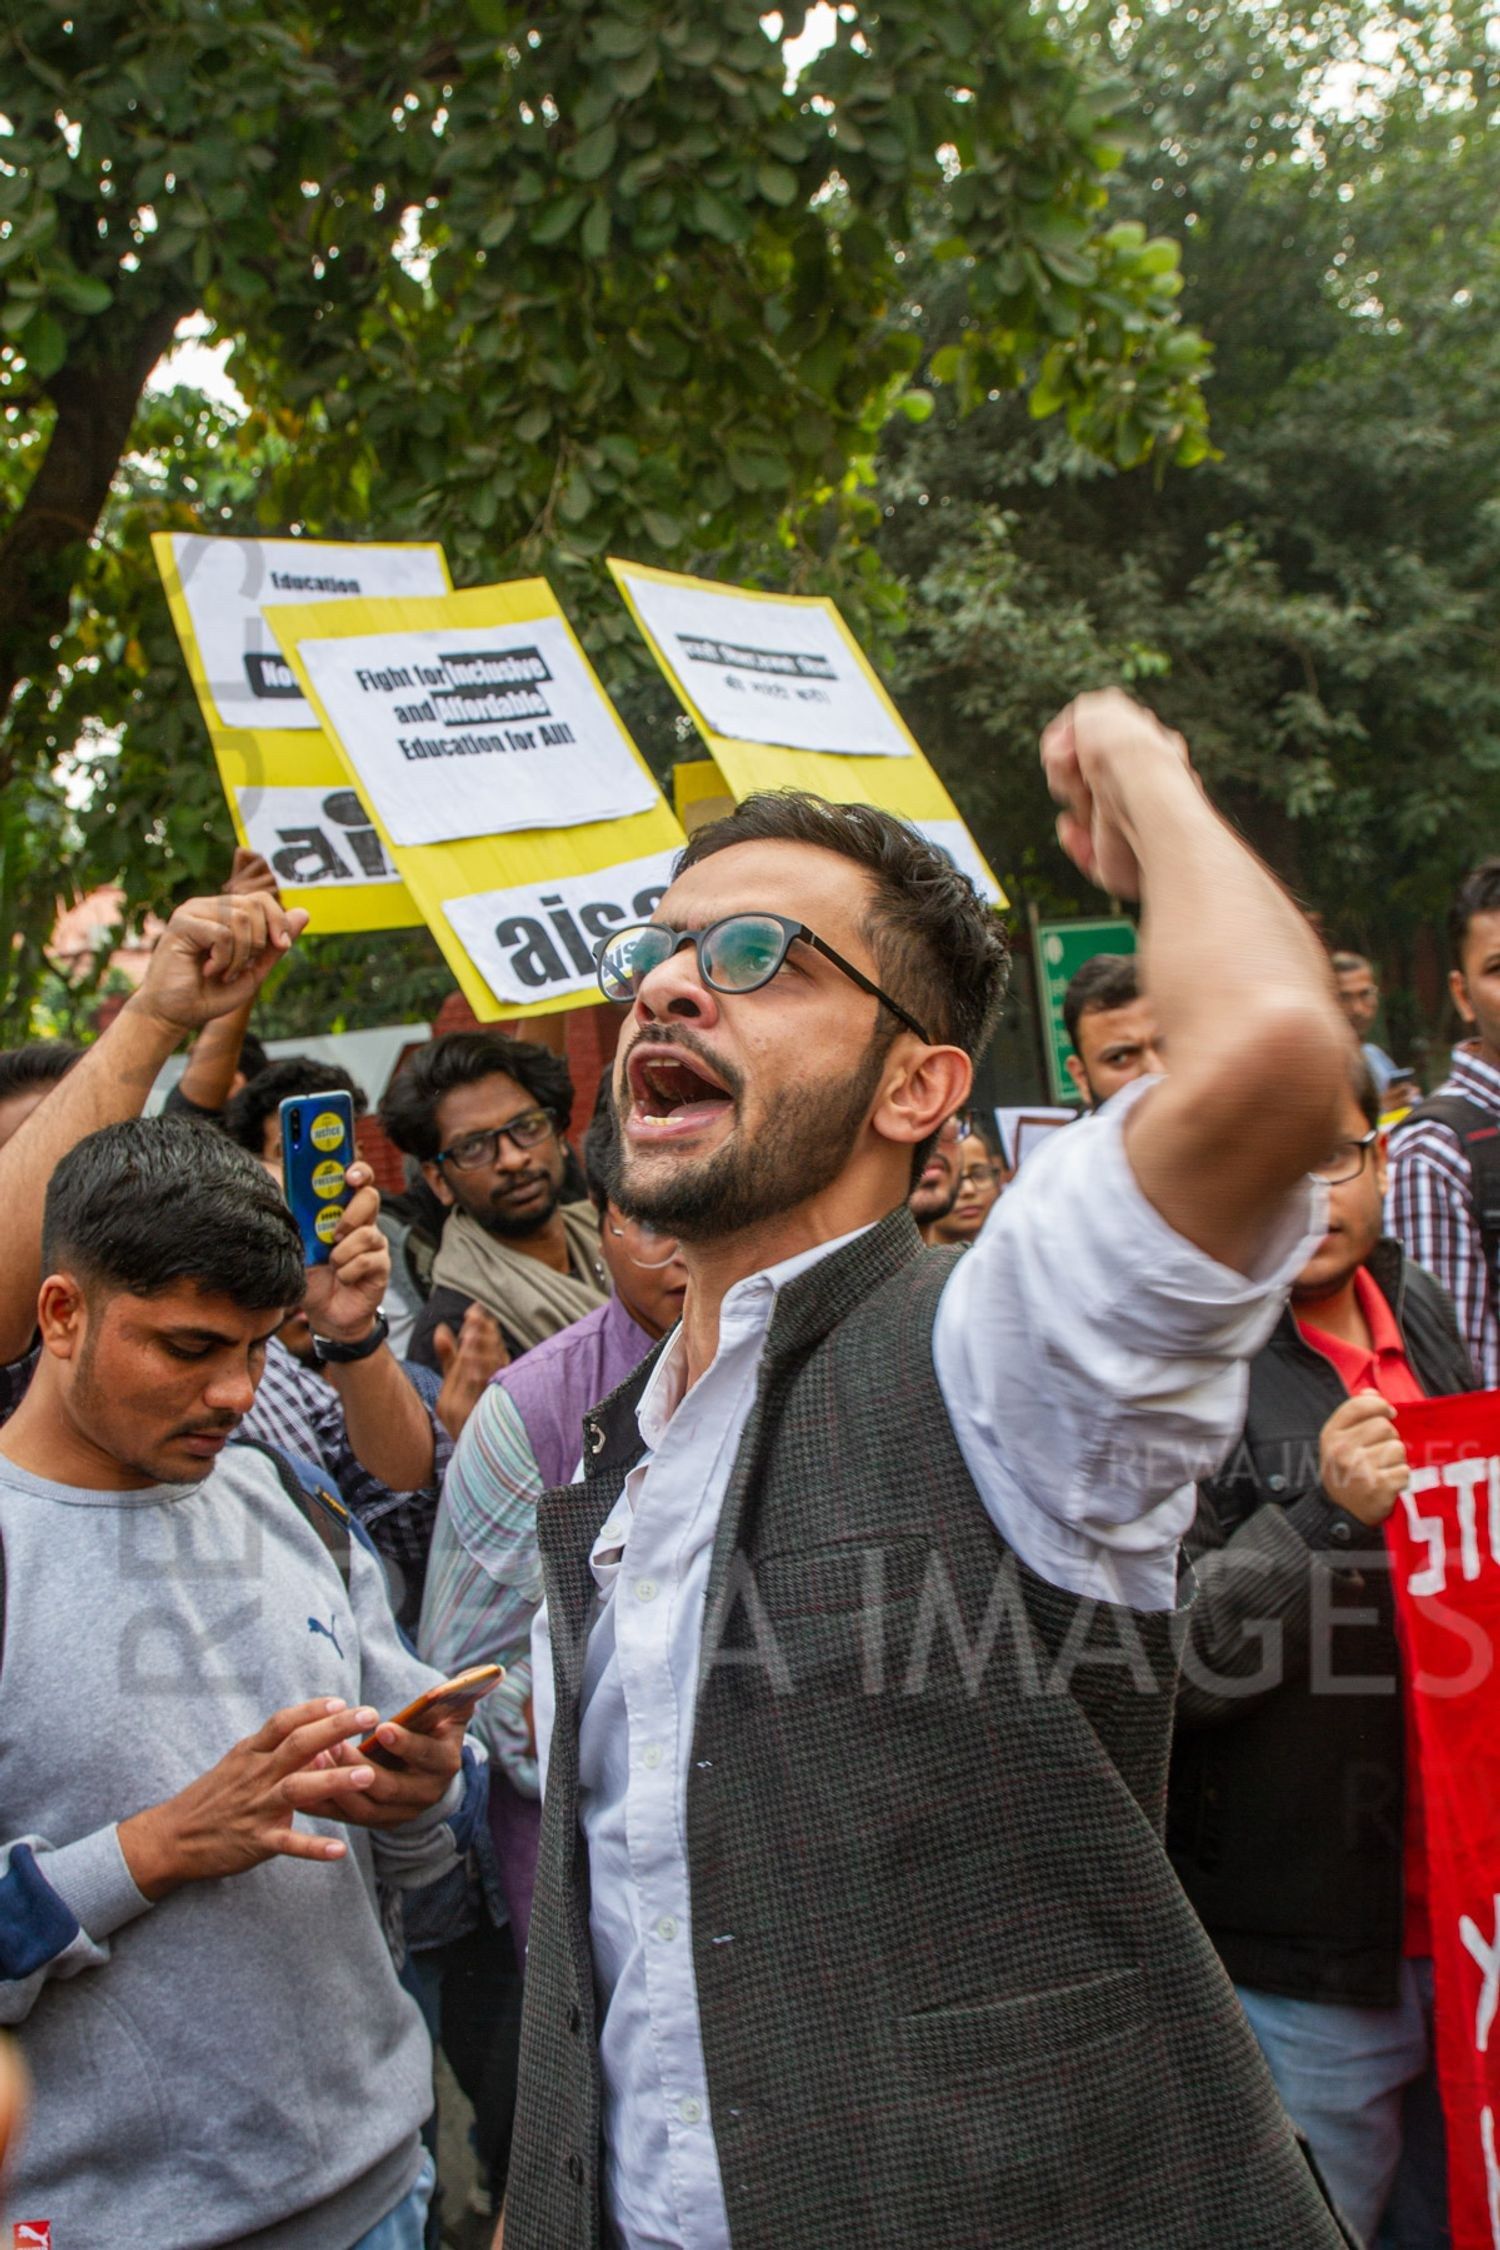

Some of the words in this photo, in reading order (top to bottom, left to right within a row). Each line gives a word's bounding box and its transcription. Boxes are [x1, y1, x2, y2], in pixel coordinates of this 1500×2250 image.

[270, 571, 361, 594] Education
[355, 664, 416, 692] Fight
[412, 663, 447, 686] for
[444, 655, 549, 688] Inclusive
[393, 699, 437, 725] and
[435, 688, 547, 724] Affordable
[397, 732, 507, 761] Education
[503, 728, 537, 752] for
[271, 789, 399, 884] ai
